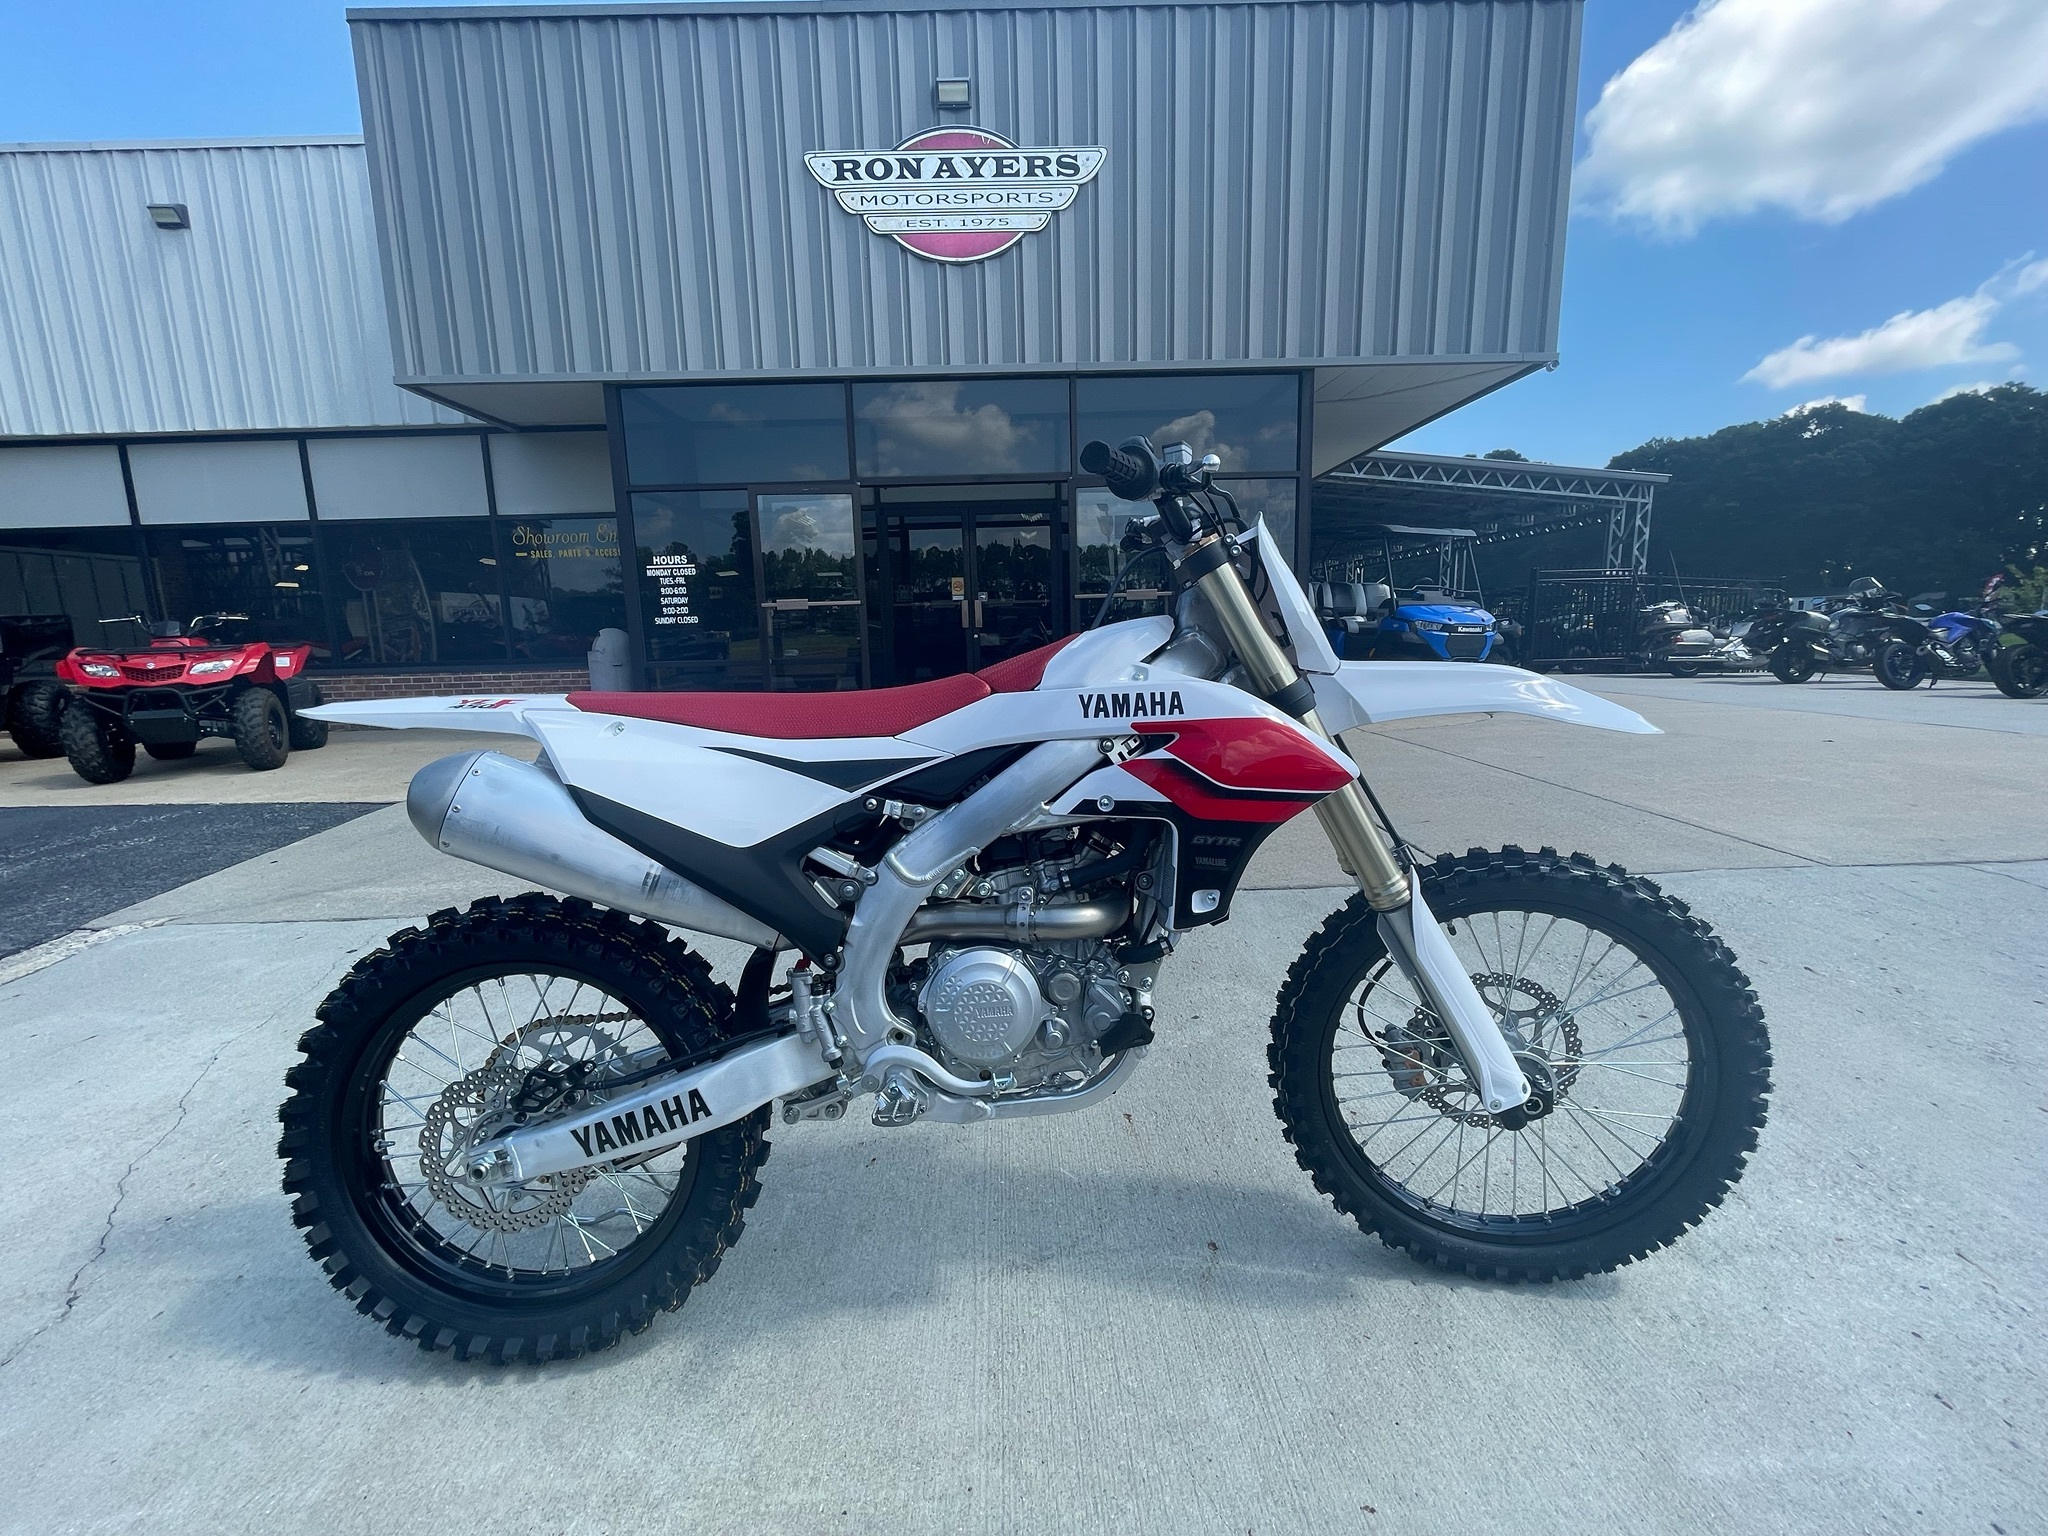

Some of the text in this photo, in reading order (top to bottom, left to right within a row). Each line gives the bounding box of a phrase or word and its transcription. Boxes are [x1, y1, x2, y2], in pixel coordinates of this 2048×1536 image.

[831, 154, 1081, 181] RON AYERS
[860, 191, 1054, 206] MOTORSPORTS
[906, 217, 1010, 228] EST. 1975
[512, 525, 590, 547] Showroom
[558, 549, 582, 558] PARTS
[585, 548, 591, 557] &
[652, 555, 688, 565] HOURS
[646, 567, 697, 577] MONDAY CLOSED
[660, 586, 687, 595] 9:00-6:00
[660, 596, 689, 605] SATURDAY
[662, 606, 689, 615] 9:00-2:00
[654, 615, 699, 625] SUNDAY CLOSED
[1078, 690, 1186, 719] YAMAHA
[1190, 834, 1243, 847] GYTR
[1194, 856, 1228, 867] YAMALUBE
[974, 1005, 1014, 1019] YAMAHA
[569, 1087, 713, 1158] YAMAHA
